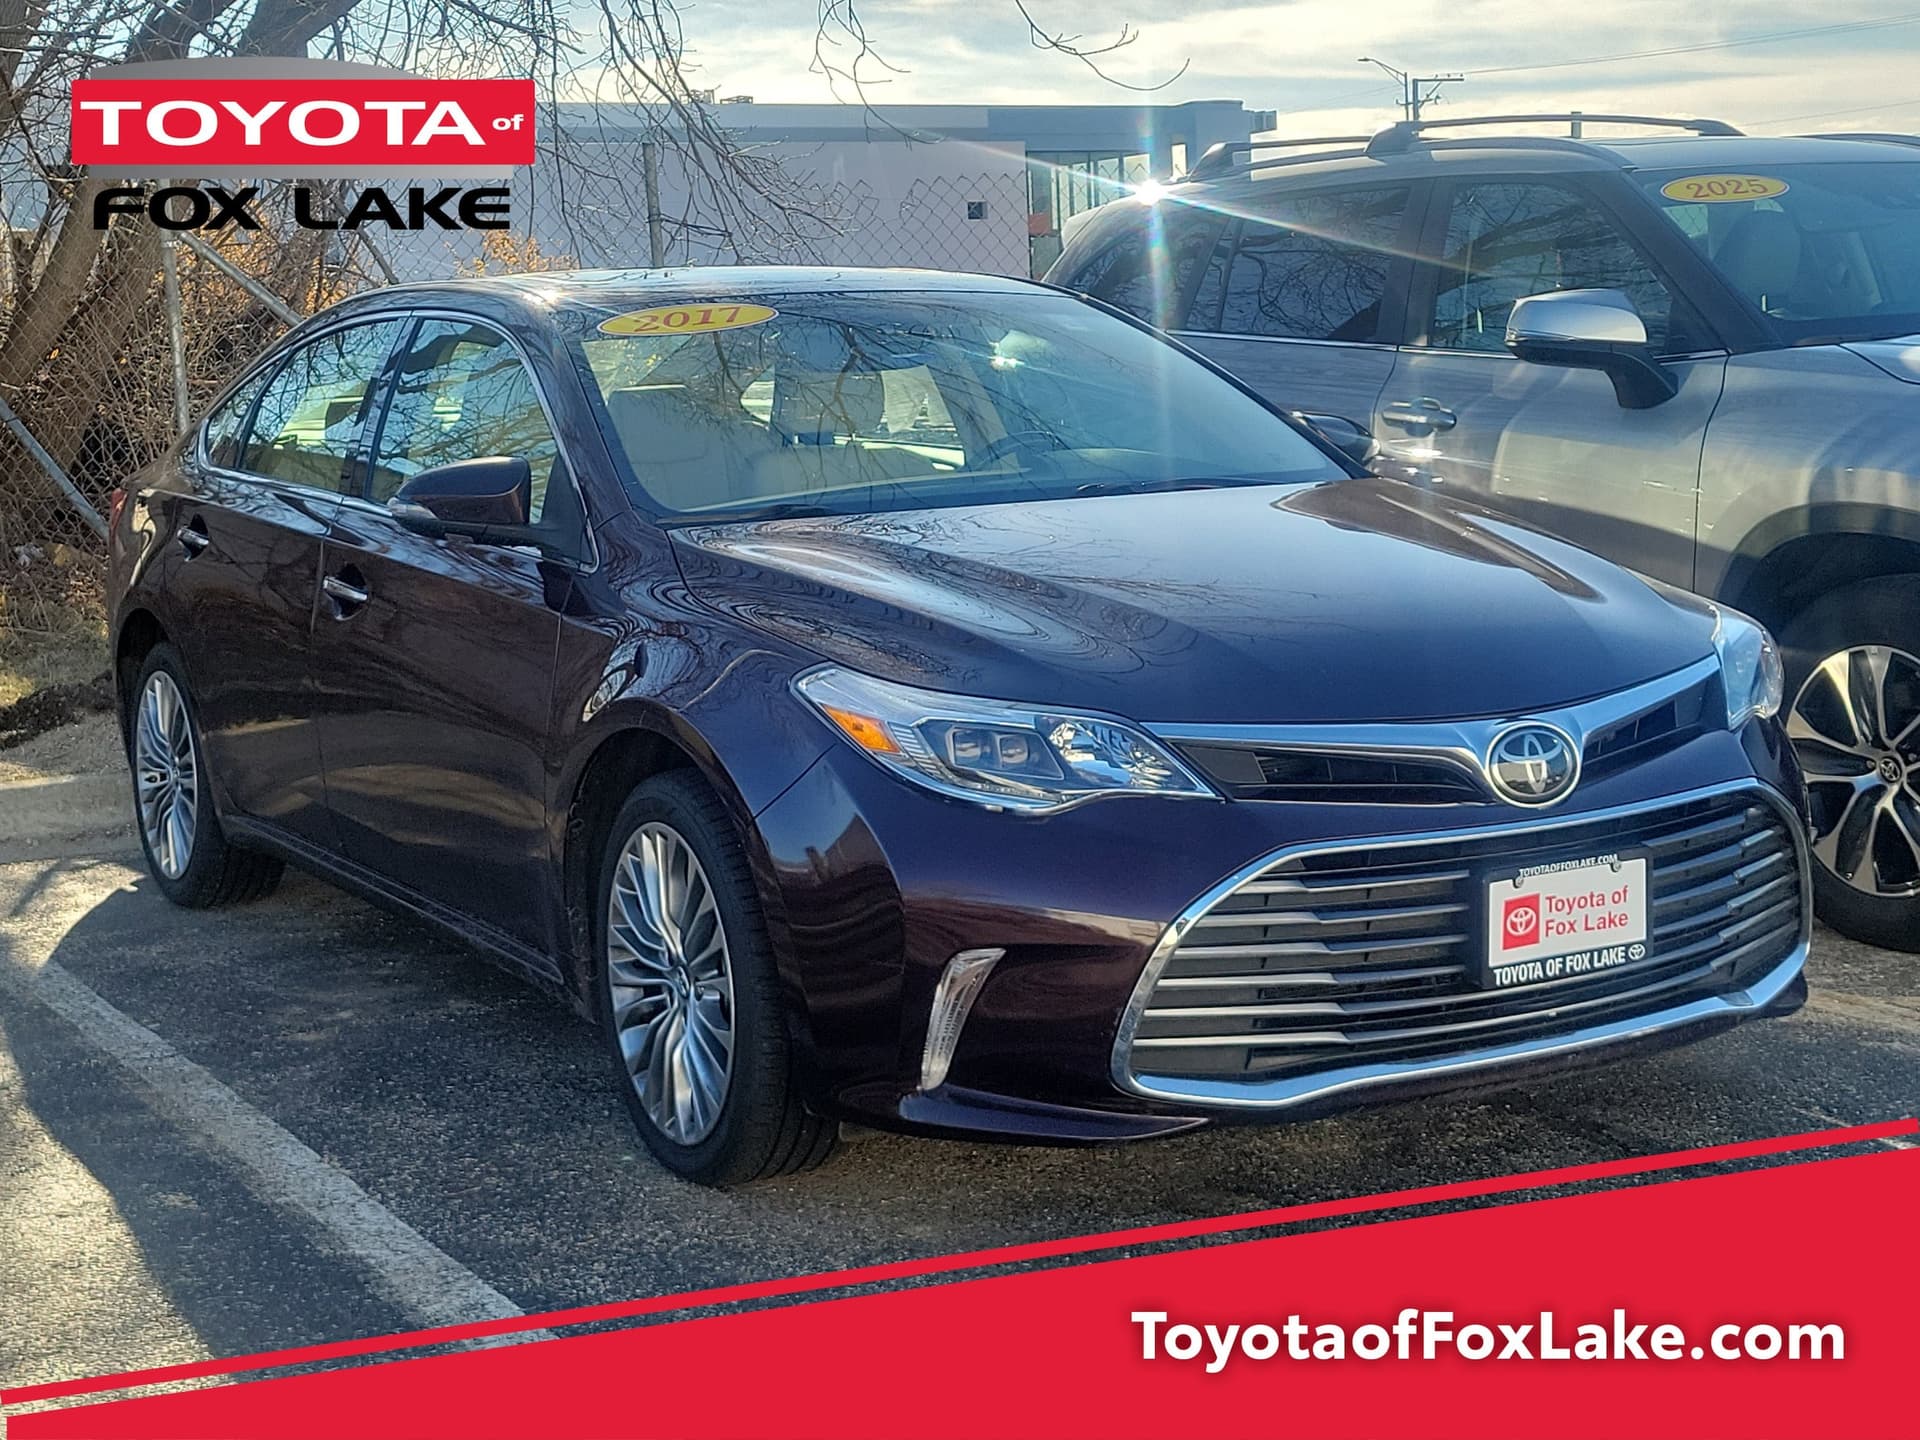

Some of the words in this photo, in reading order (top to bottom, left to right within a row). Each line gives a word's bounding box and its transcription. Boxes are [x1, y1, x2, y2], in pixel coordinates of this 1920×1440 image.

[1686, 179, 1768, 199] 2025
[633, 306, 742, 332] 2017
[1518, 854, 1618, 878] TOYOTAOFFOXLAKE.COM
[1545, 891, 1605, 915] Toyota
[1611, 885, 1629, 904] of
[1545, 919, 1577, 938] Fox
[1583, 911, 1629, 931] Lake
[1493, 961, 1543, 986] TOYOTA
[1546, 957, 1564, 976] OF
[1566, 951, 1591, 973] FOX
[1593, 946, 1626, 968] LAKE
